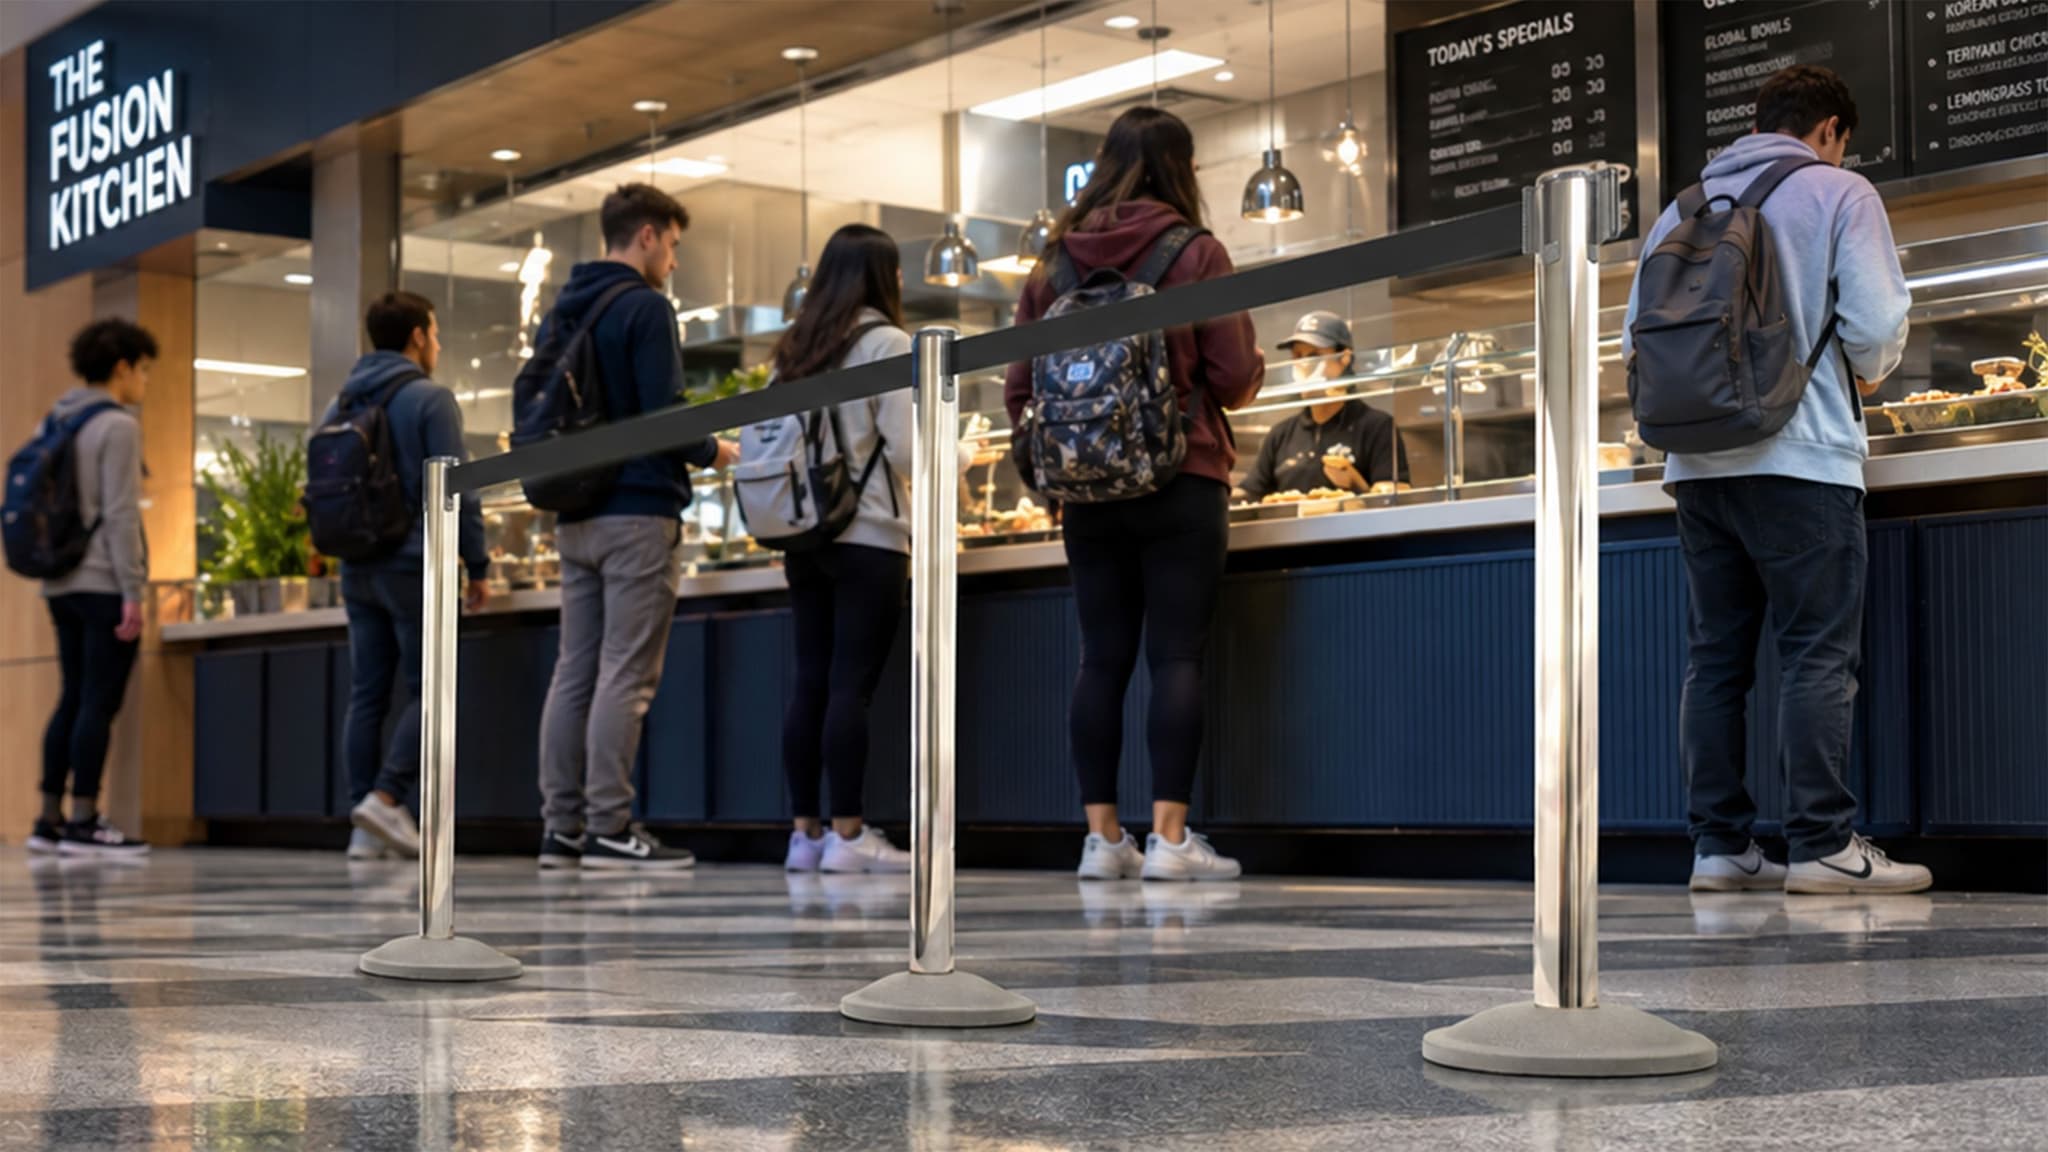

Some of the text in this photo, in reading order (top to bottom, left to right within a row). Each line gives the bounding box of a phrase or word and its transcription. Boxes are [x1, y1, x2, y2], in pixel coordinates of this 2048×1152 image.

[1427, 12, 1574, 67] TODAY'S SPECIALS
[1750, 17, 1792, 40] BOWLS
[1945, 0, 1998, 19] KOREAN
[49, 39, 104, 113] THE
[50, 69, 173, 182] FUSION
[50, 134, 192, 251] KITCHEN
